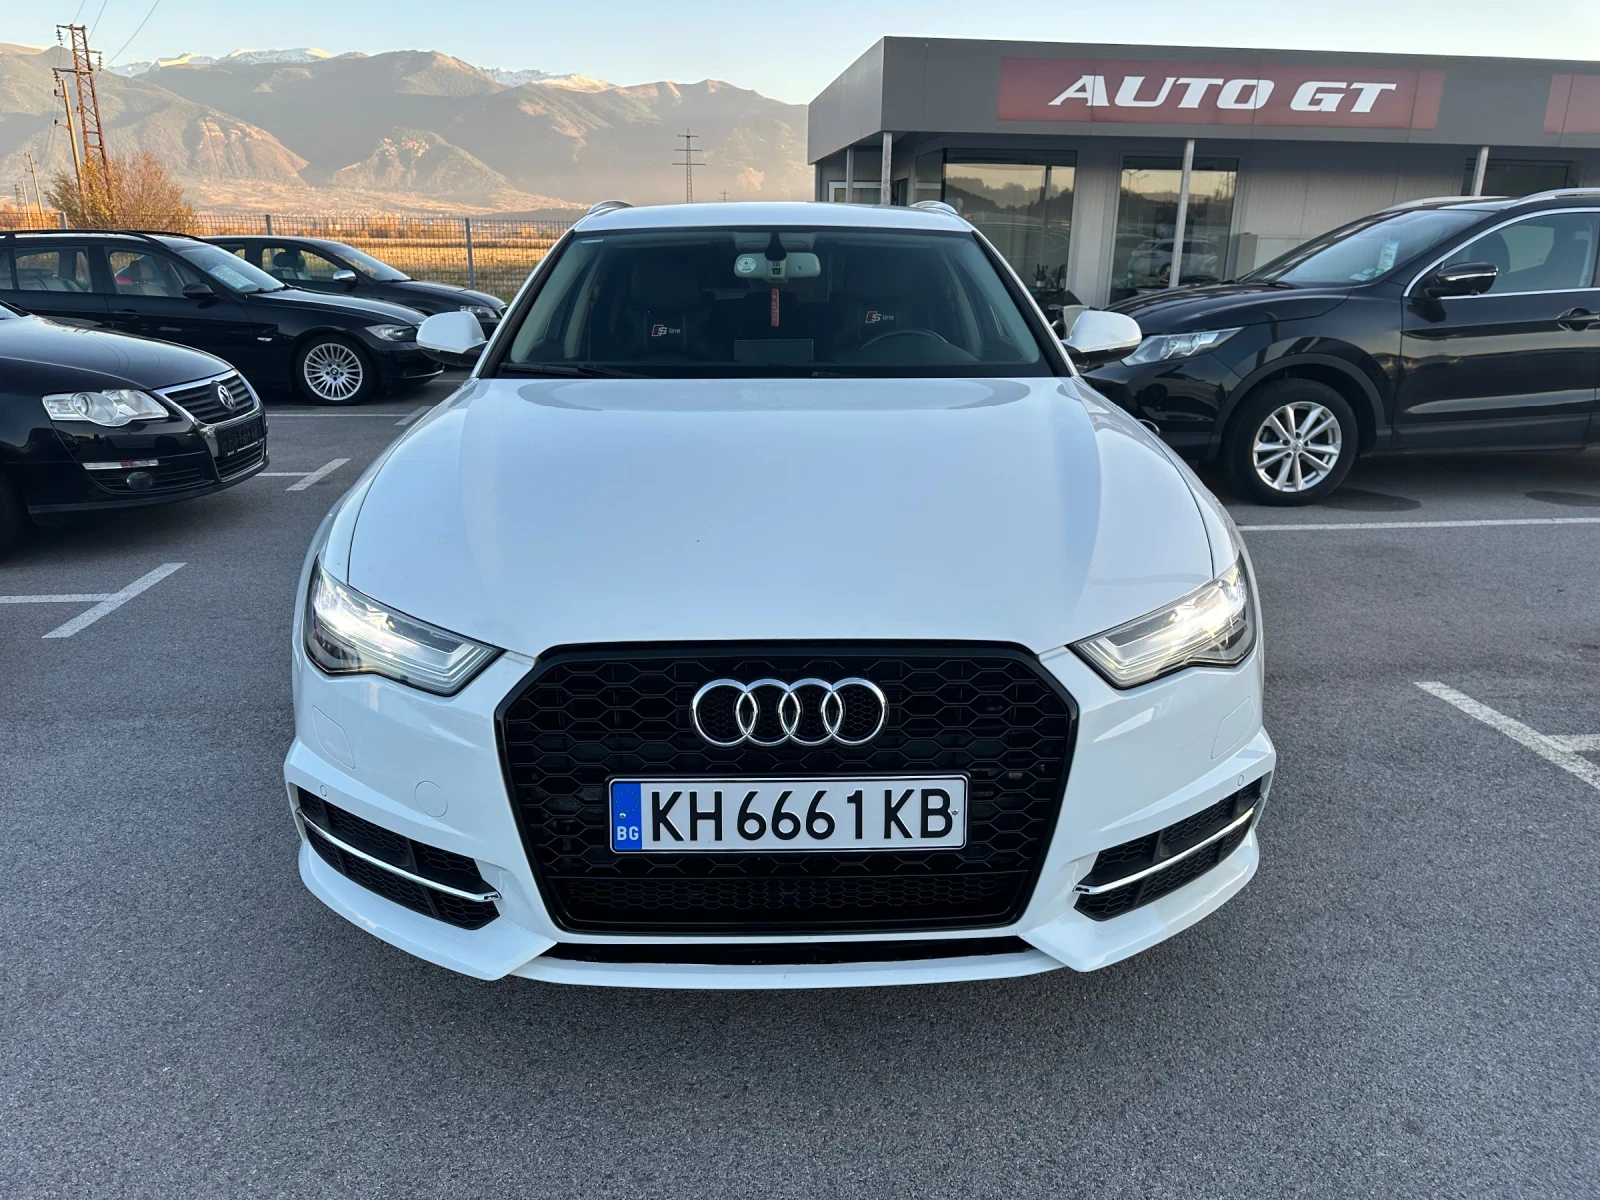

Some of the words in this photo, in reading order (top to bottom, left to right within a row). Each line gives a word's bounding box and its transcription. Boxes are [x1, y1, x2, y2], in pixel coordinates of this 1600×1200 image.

[1048, 75, 1274, 109] AUTO
[1290, 81, 1397, 113] GT
[617, 825, 639, 841] BG
[652, 790, 723, 842] KH
[737, 789, 863, 841] 6661
[884, 788, 953, 840] KB
